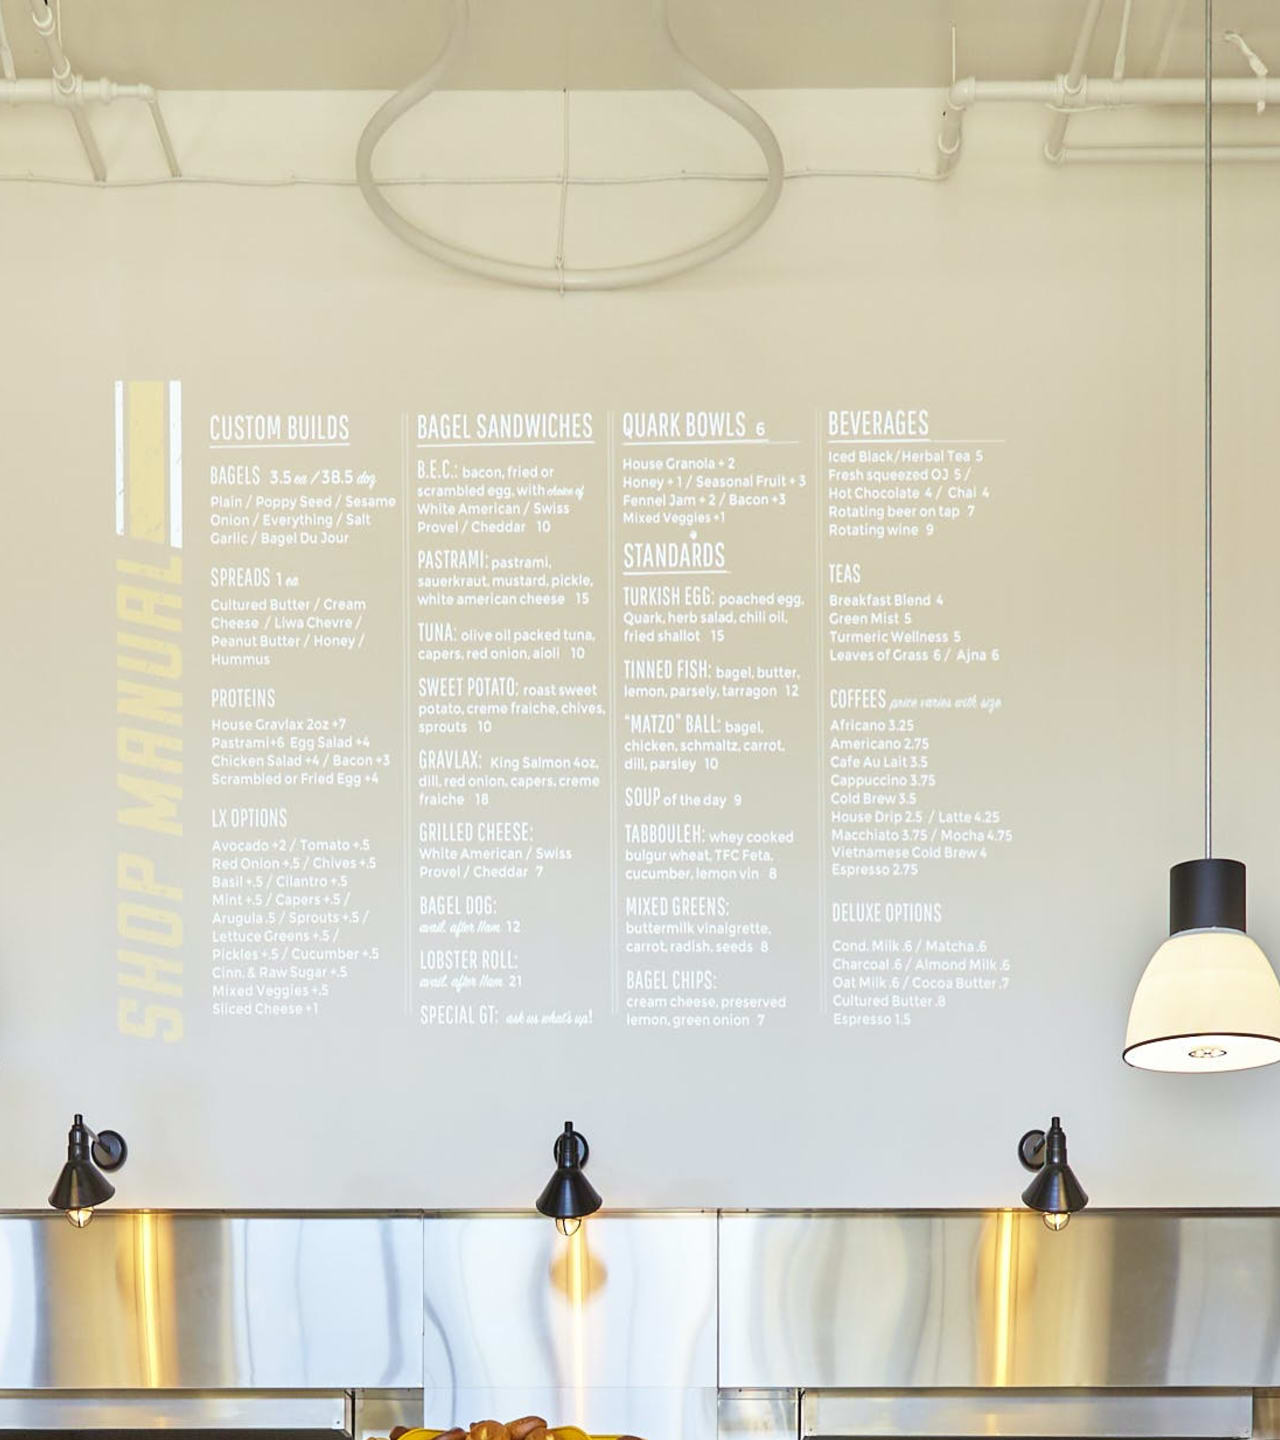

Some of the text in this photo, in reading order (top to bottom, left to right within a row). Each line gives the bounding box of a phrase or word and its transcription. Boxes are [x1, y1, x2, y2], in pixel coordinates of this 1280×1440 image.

[210, 414, 349, 441] CUSTOM BUILDS
[417, 412, 593, 439] BAGEL SANDWICHES
[623, 411, 746, 439] QUARK BOWLS
[828, 409, 929, 436] BEVERAGES
[623, 457, 715, 470] House Granola
[210, 465, 260, 485] BAGELS
[507, 465, 538, 479] fried
[696, 474, 786, 488] Seasonal Fruit
[346, 495, 396, 508] Sesame
[729, 493, 769, 506] Bacon
[533, 502, 570, 514] Swiss
[346, 513, 371, 526] Salt
[623, 511, 711, 526] Mixed Veggies
[417, 520, 526, 533] Provel Cheddar
[829, 523, 885, 539] Rotating
[321, 531, 349, 544] Jour
[418, 549, 489, 569] PASTRAMI:
[624, 541, 725, 568] STANDARDS
[210, 567, 270, 587] SPREADS
[828, 563, 861, 584] TEAS
[417, 592, 565, 606] white american cheese
[623, 586, 775, 608] TURKISH EGG: poached
[829, 593, 931, 607] Breakfast Blend
[210, 598, 366, 611] Cultured Butter Cream
[668, 610, 766, 624] herb chili
[829, 612, 868, 625] Green
[417, 622, 561, 644] TUNA: olive oil packed
[624, 629, 700, 643] fried shallot
[829, 630, 949, 643] Turmeric Wellness
[260, 635, 355, 650] Butter Honey
[211, 653, 270, 666] Hummus
[466, 646, 560, 660] red aioli
[829, 648, 987, 664] Leaves Grass Ajna
[624, 659, 711, 680] TINNED FISH:
[418, 676, 597, 697] SWEET POTATO: roast sweet
[722, 685, 777, 700] tarragon
[211, 688, 275, 708] PROTEINS
[830, 688, 886, 709] COFFEES
[467, 704, 508, 714] creme
[212, 718, 329, 731] House Gravlax 2oz
[418, 721, 467, 735] sprouts
[686, 714, 721, 733] BALL:
[830, 719, 914, 732] Africano 3.25
[318, 736, 352, 748] Salad
[830, 737, 929, 750] Americano 2.75
[419, 749, 571, 772] GRAVLAX: King Salmon
[650, 757, 696, 773] parsley
[910, 755, 928, 768] 3.5
[212, 772, 361, 787] Scrambled Fried Egg
[558, 776, 600, 787] creme
[830, 774, 936, 788] Cappuccino 3.75
[116, 555, 185, 1044] SHOP MANUAL
[419, 792, 465, 806] fraiche
[625, 786, 727, 809] SOUP of the day
[830, 792, 917, 805] Cold Brew 3.5
[212, 808, 287, 828] LX OPTIONS
[938, 811, 1000, 824] Latte 4.25
[419, 822, 533, 842] GRILLED CHEESE:
[625, 823, 794, 846] TABBOULEH: whey cooked
[832, 829, 1012, 842] Macchiato 4.75
[300, 839, 350, 851] Tomato
[419, 847, 572, 860] White American Swiss
[625, 849, 666, 864] bulgur
[912, 846, 978, 859] Cold Brew
[313, 856, 357, 869] Chives
[420, 865, 528, 878] Provel Cheddar
[696, 867, 737, 880] lemon
[832, 863, 918, 878] Espresso 2.75
[420, 895, 496, 915] BAGEL DOG:
[626, 896, 729, 916] MIXED GREENS:
[832, 902, 942, 922] DELUXE OPTIONS
[626, 921, 694, 934] buttermilk
[716, 940, 753, 953] seeds
[872, 939, 974, 952] Milk Matcha
[420, 950, 518, 970] LOBSTER ROLL:
[627, 970, 717, 990] BAGEL CHIPS:
[626, 997, 786, 1009] cream preserved
[833, 994, 889, 1007] Cultured
[420, 1005, 475, 1024] SPECIAL
[672, 1013, 750, 1029] green onion
[834, 1013, 891, 1027] Espresso
